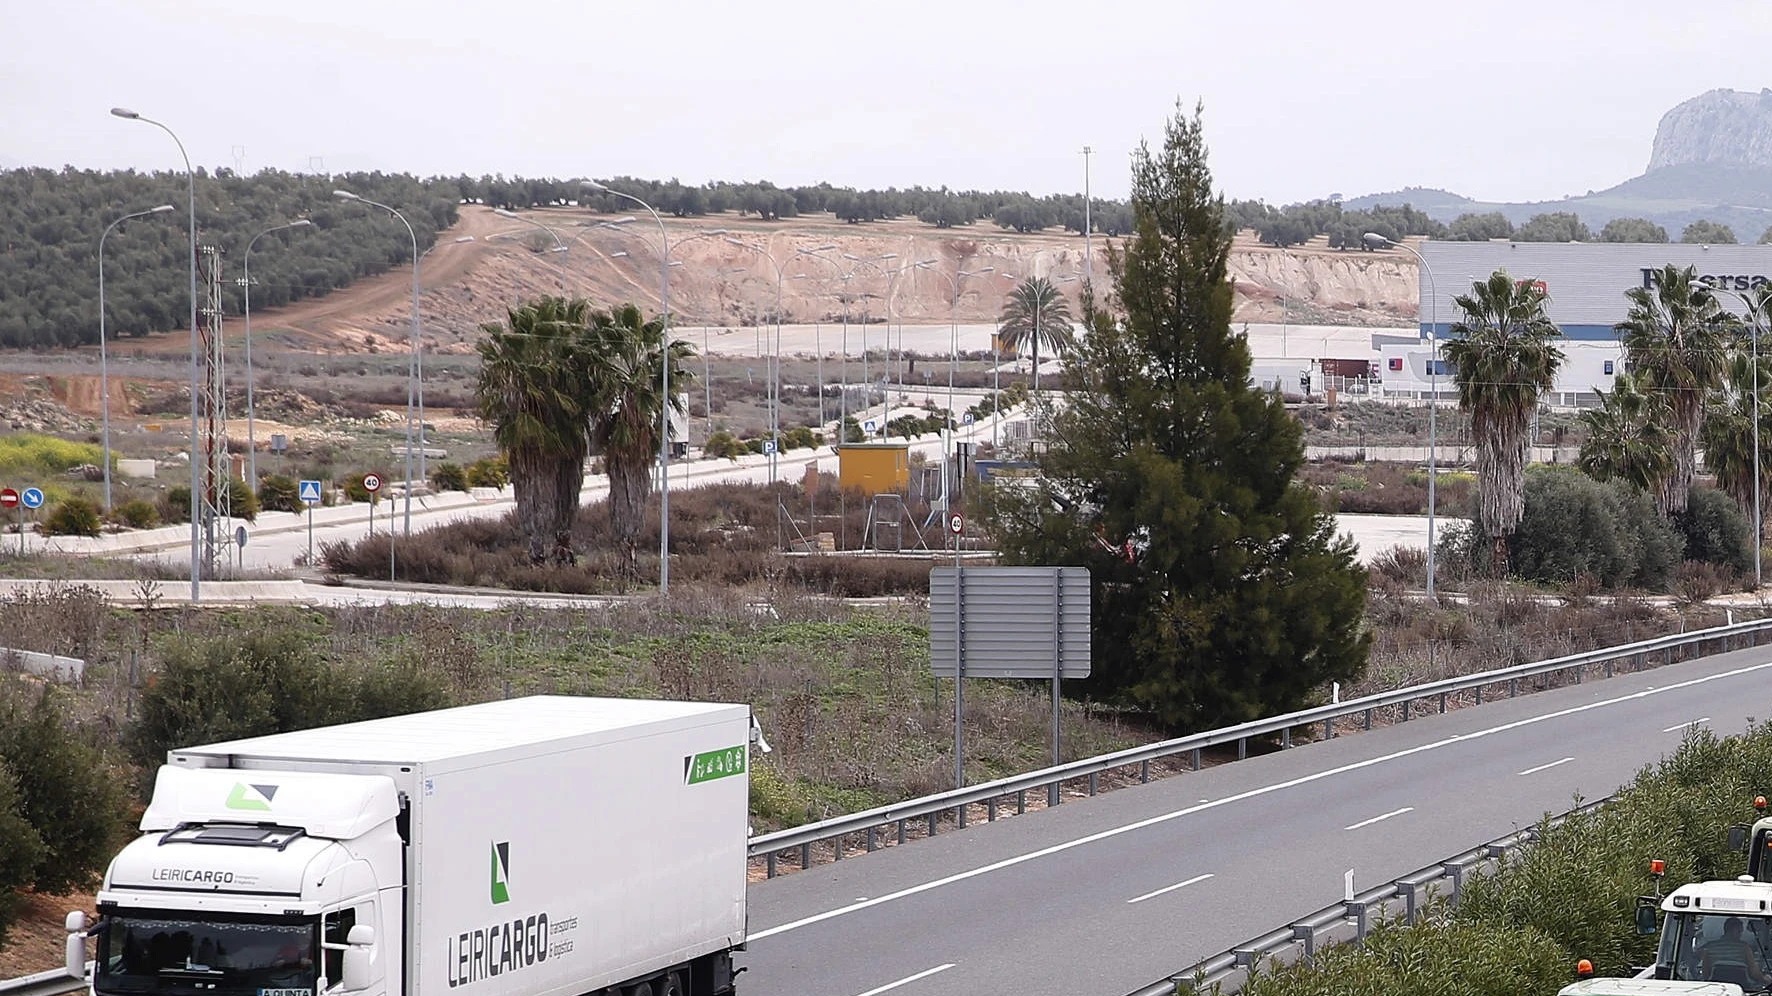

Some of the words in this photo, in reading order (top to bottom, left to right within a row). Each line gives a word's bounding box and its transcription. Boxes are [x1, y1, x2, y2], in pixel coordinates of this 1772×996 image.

[764, 442, 774, 453] P
[152, 868, 234, 883] LEIRICARGO
[448, 912, 549, 989] LEIRICARGO
